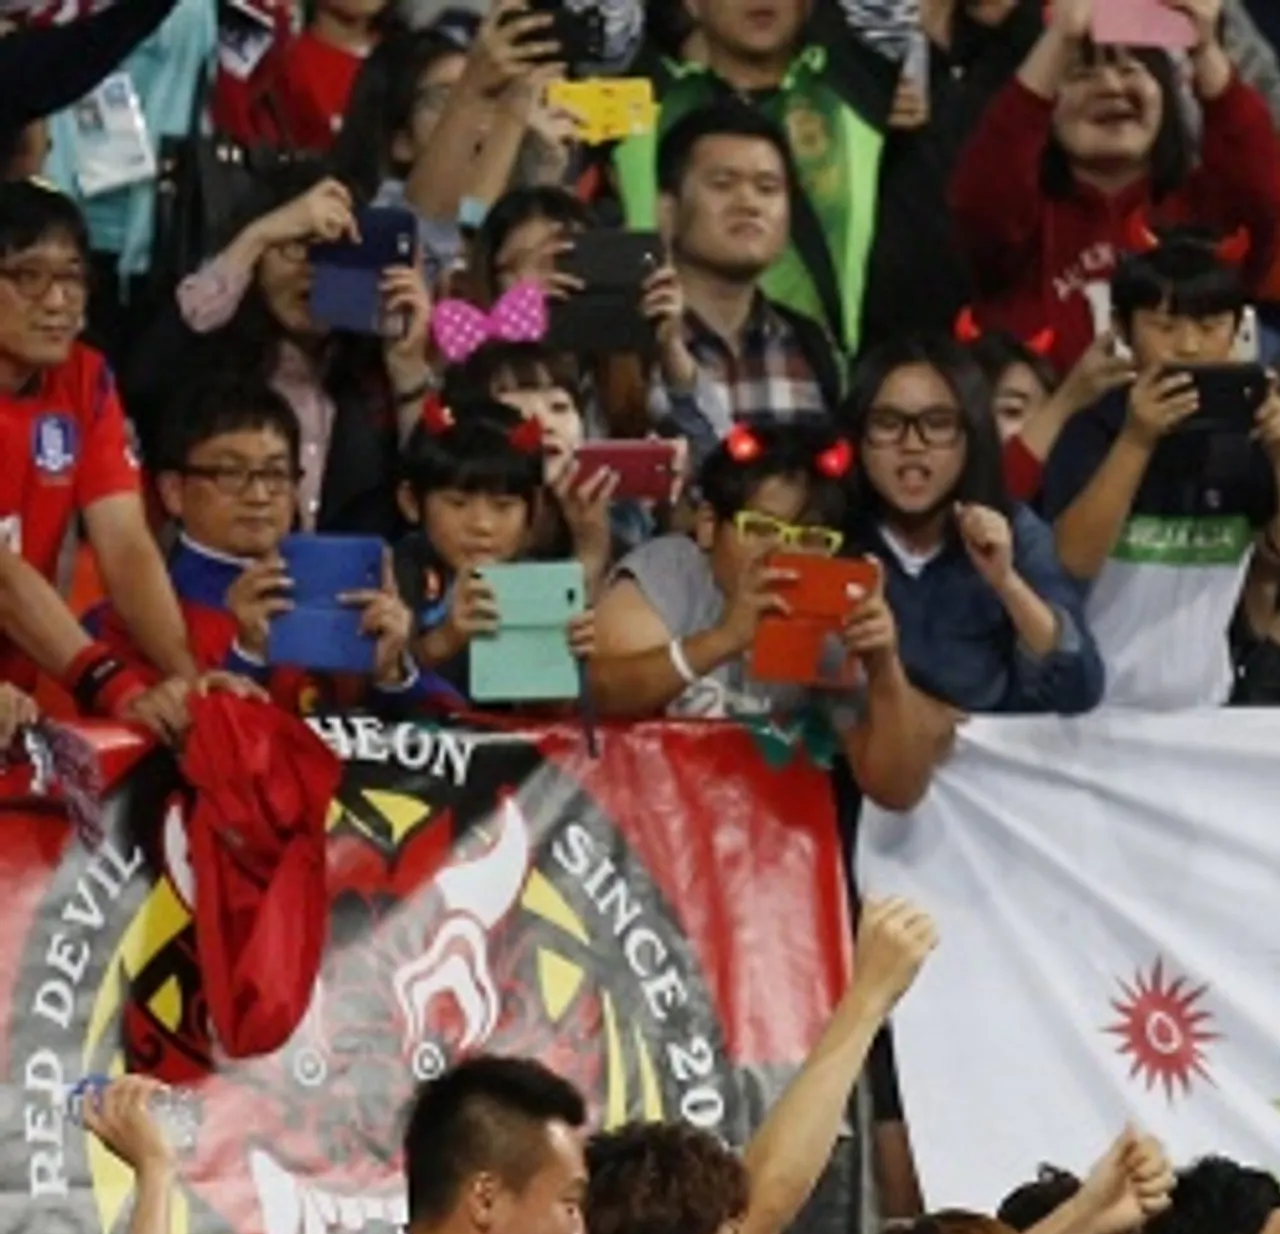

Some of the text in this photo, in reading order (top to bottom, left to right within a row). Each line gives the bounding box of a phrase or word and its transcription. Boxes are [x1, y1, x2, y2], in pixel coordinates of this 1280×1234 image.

[25, 842, 143, 1198] RED DEVIL
[553, 823, 724, 1128] SINCE 20
